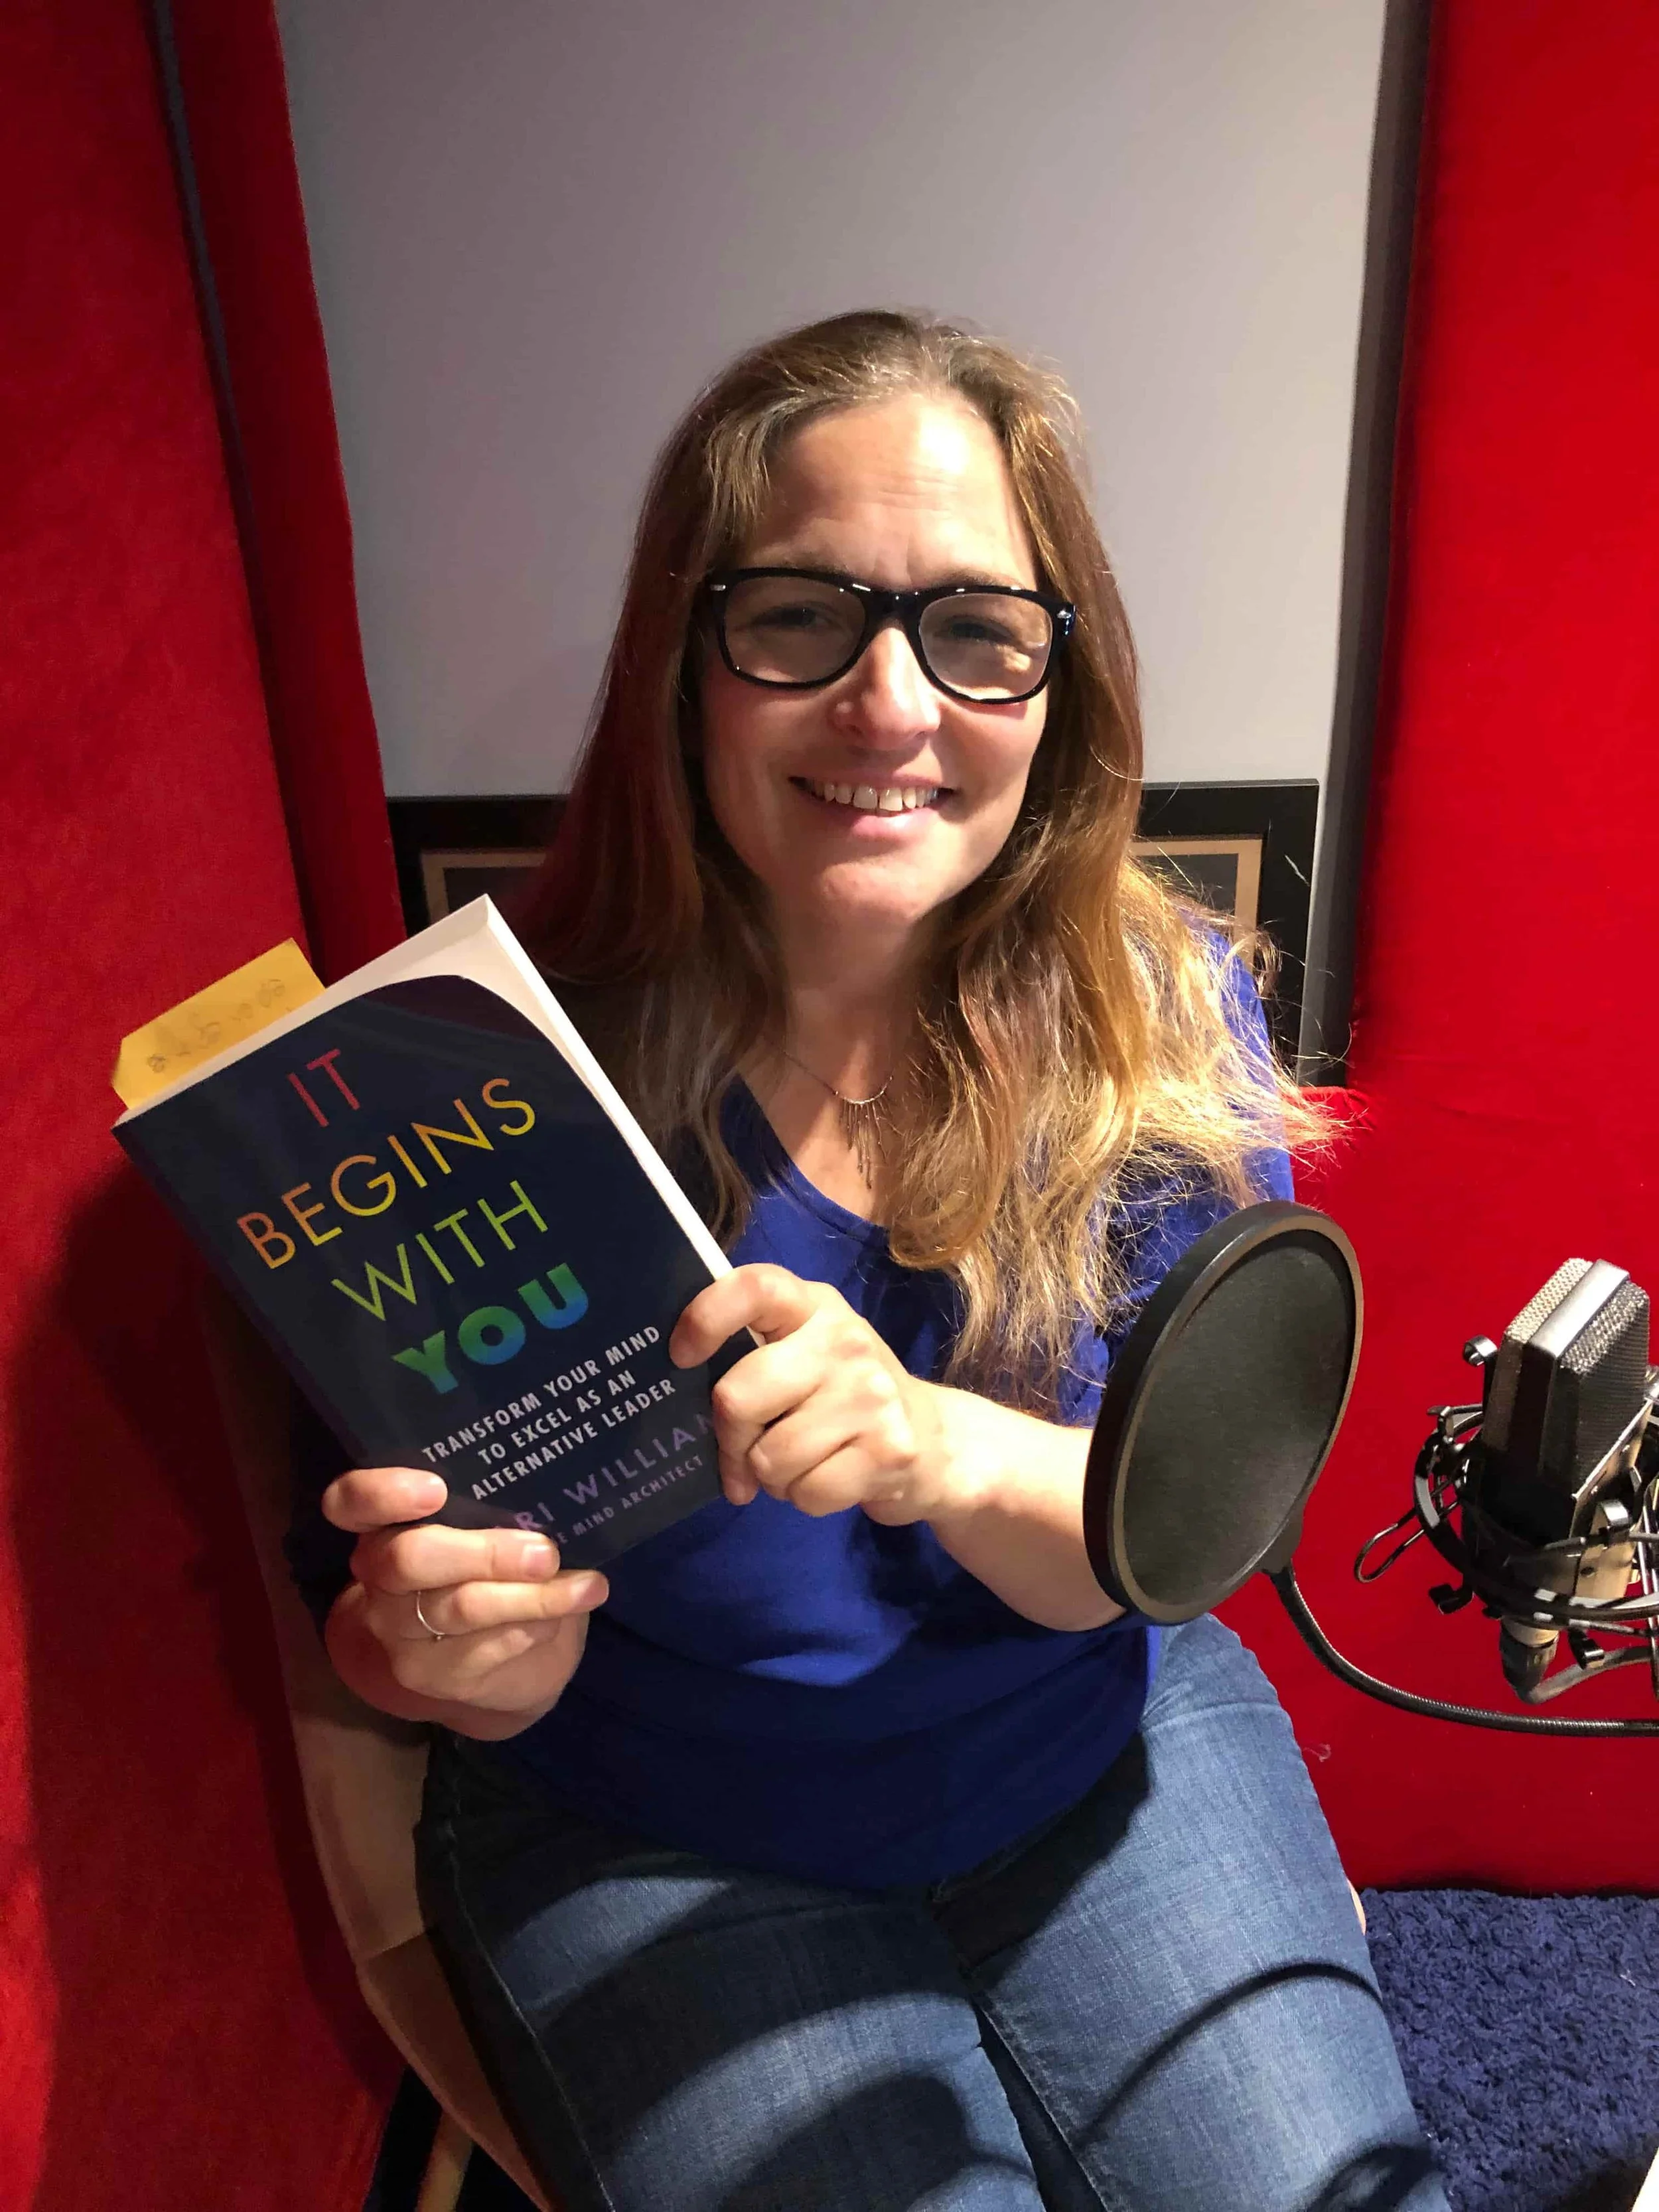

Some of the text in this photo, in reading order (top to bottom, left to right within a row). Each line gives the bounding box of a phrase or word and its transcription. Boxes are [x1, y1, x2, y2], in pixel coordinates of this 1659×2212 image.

[287, 1048, 360, 1127] IT
[236, 1078, 536, 1269] BEGINS
[330, 1179, 549, 1321] WITH
[392, 1262, 589, 1394] YOU
[421, 1326, 660, 1463] TRANSFORM YOUR MIND
[471, 1378, 676, 1501] ALTERNATIVE LEADER
[477, 1369, 636, 1465] TO EXCEL AS AN
[514, 1501, 556, 1529] RI
[572, 1455, 703, 1536] MIND ARCHITECT
